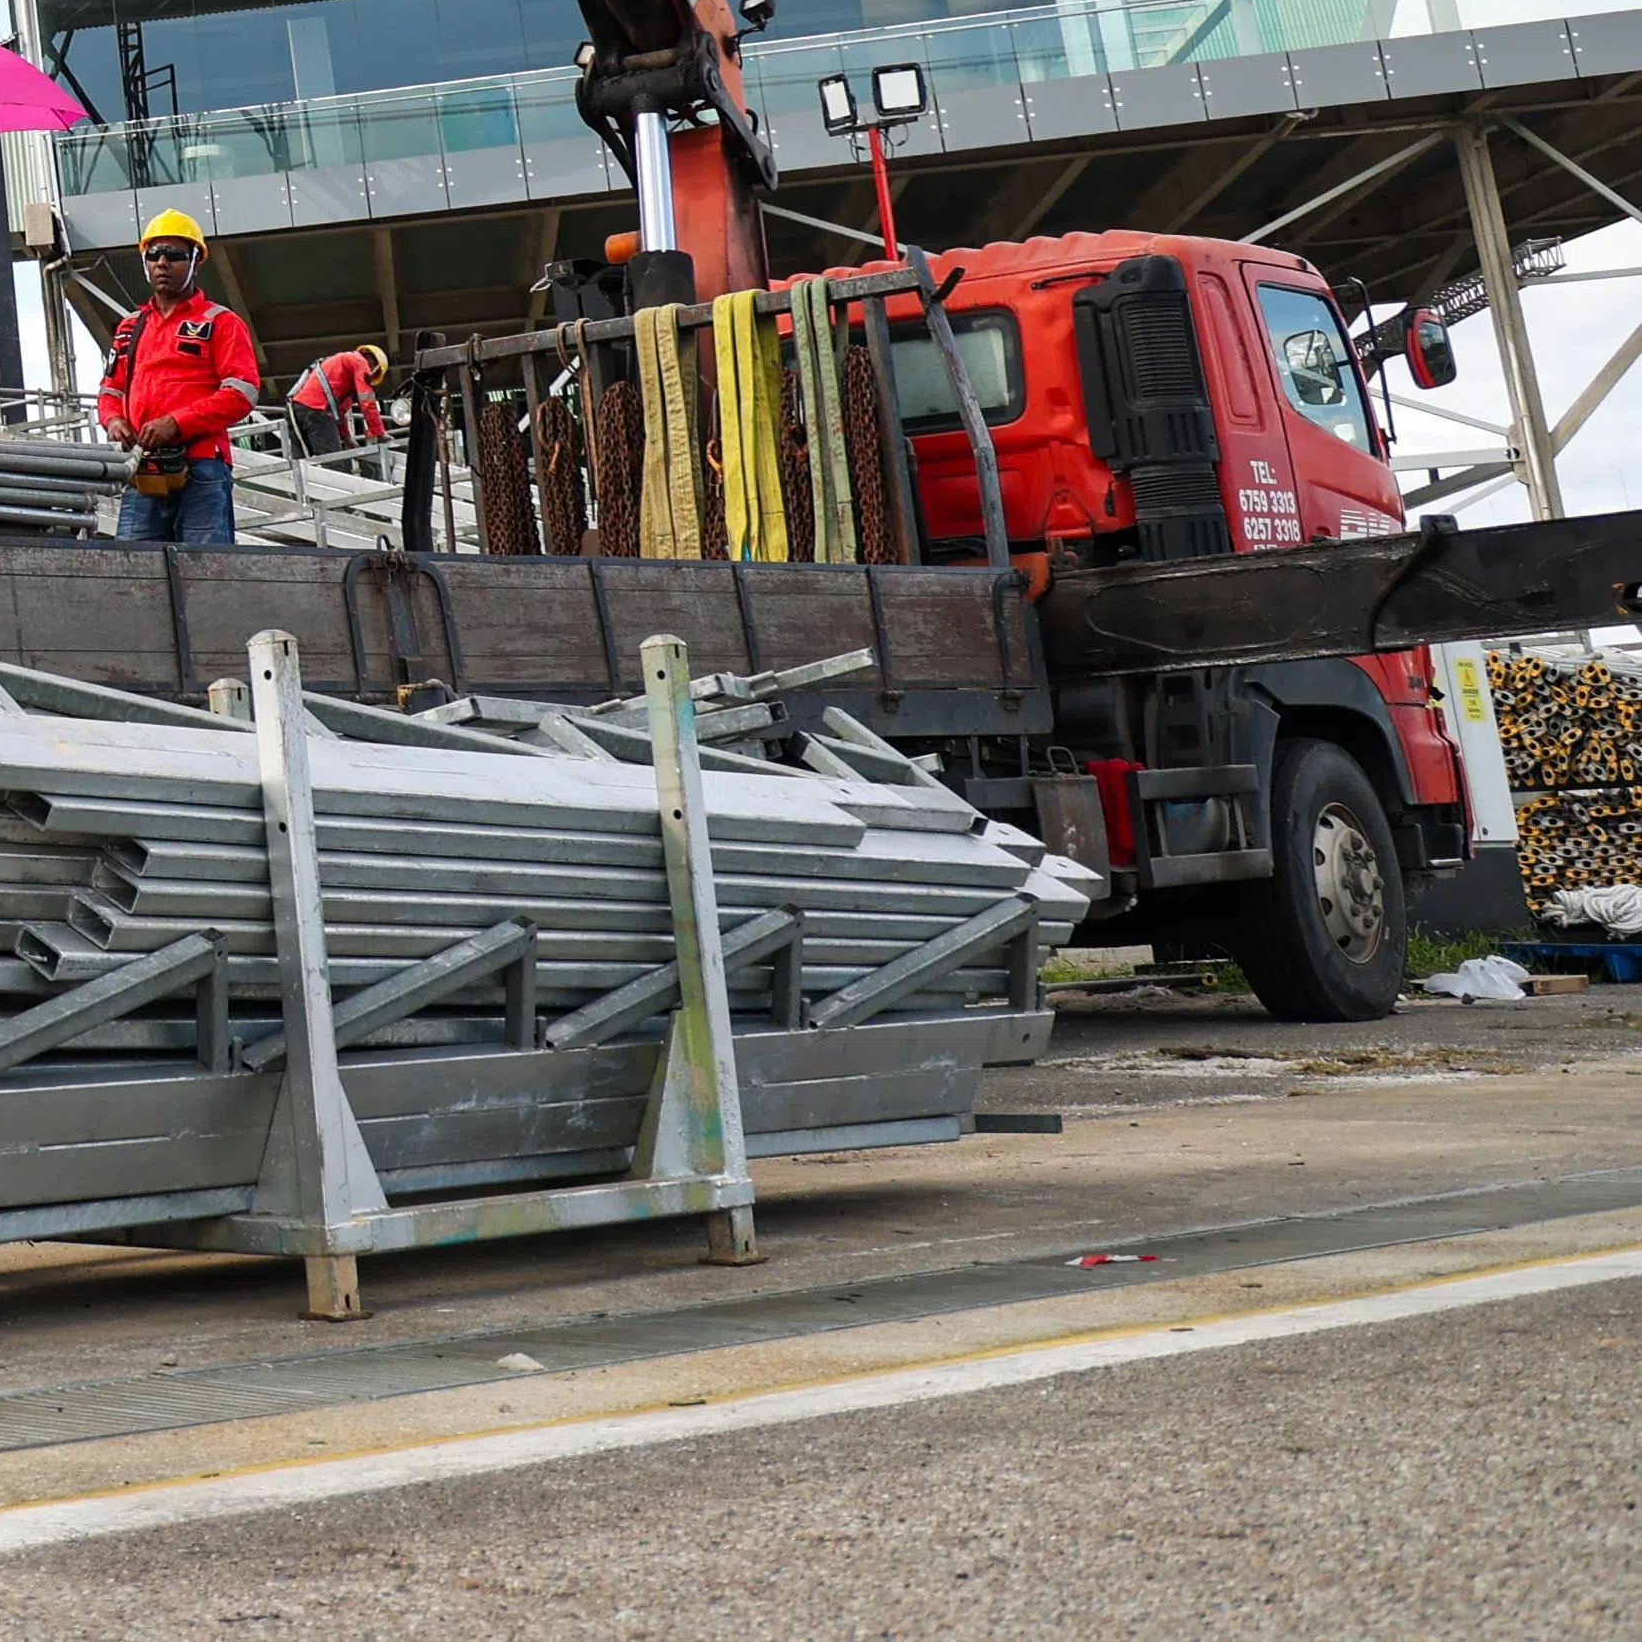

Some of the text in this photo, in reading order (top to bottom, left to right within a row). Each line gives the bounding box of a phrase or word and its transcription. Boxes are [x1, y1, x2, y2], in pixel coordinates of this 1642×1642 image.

[1250, 460, 1277, 485] TEL:
[1239, 489, 1296, 514] 6759 3313
[1244, 517, 1301, 542] 6257 3318
